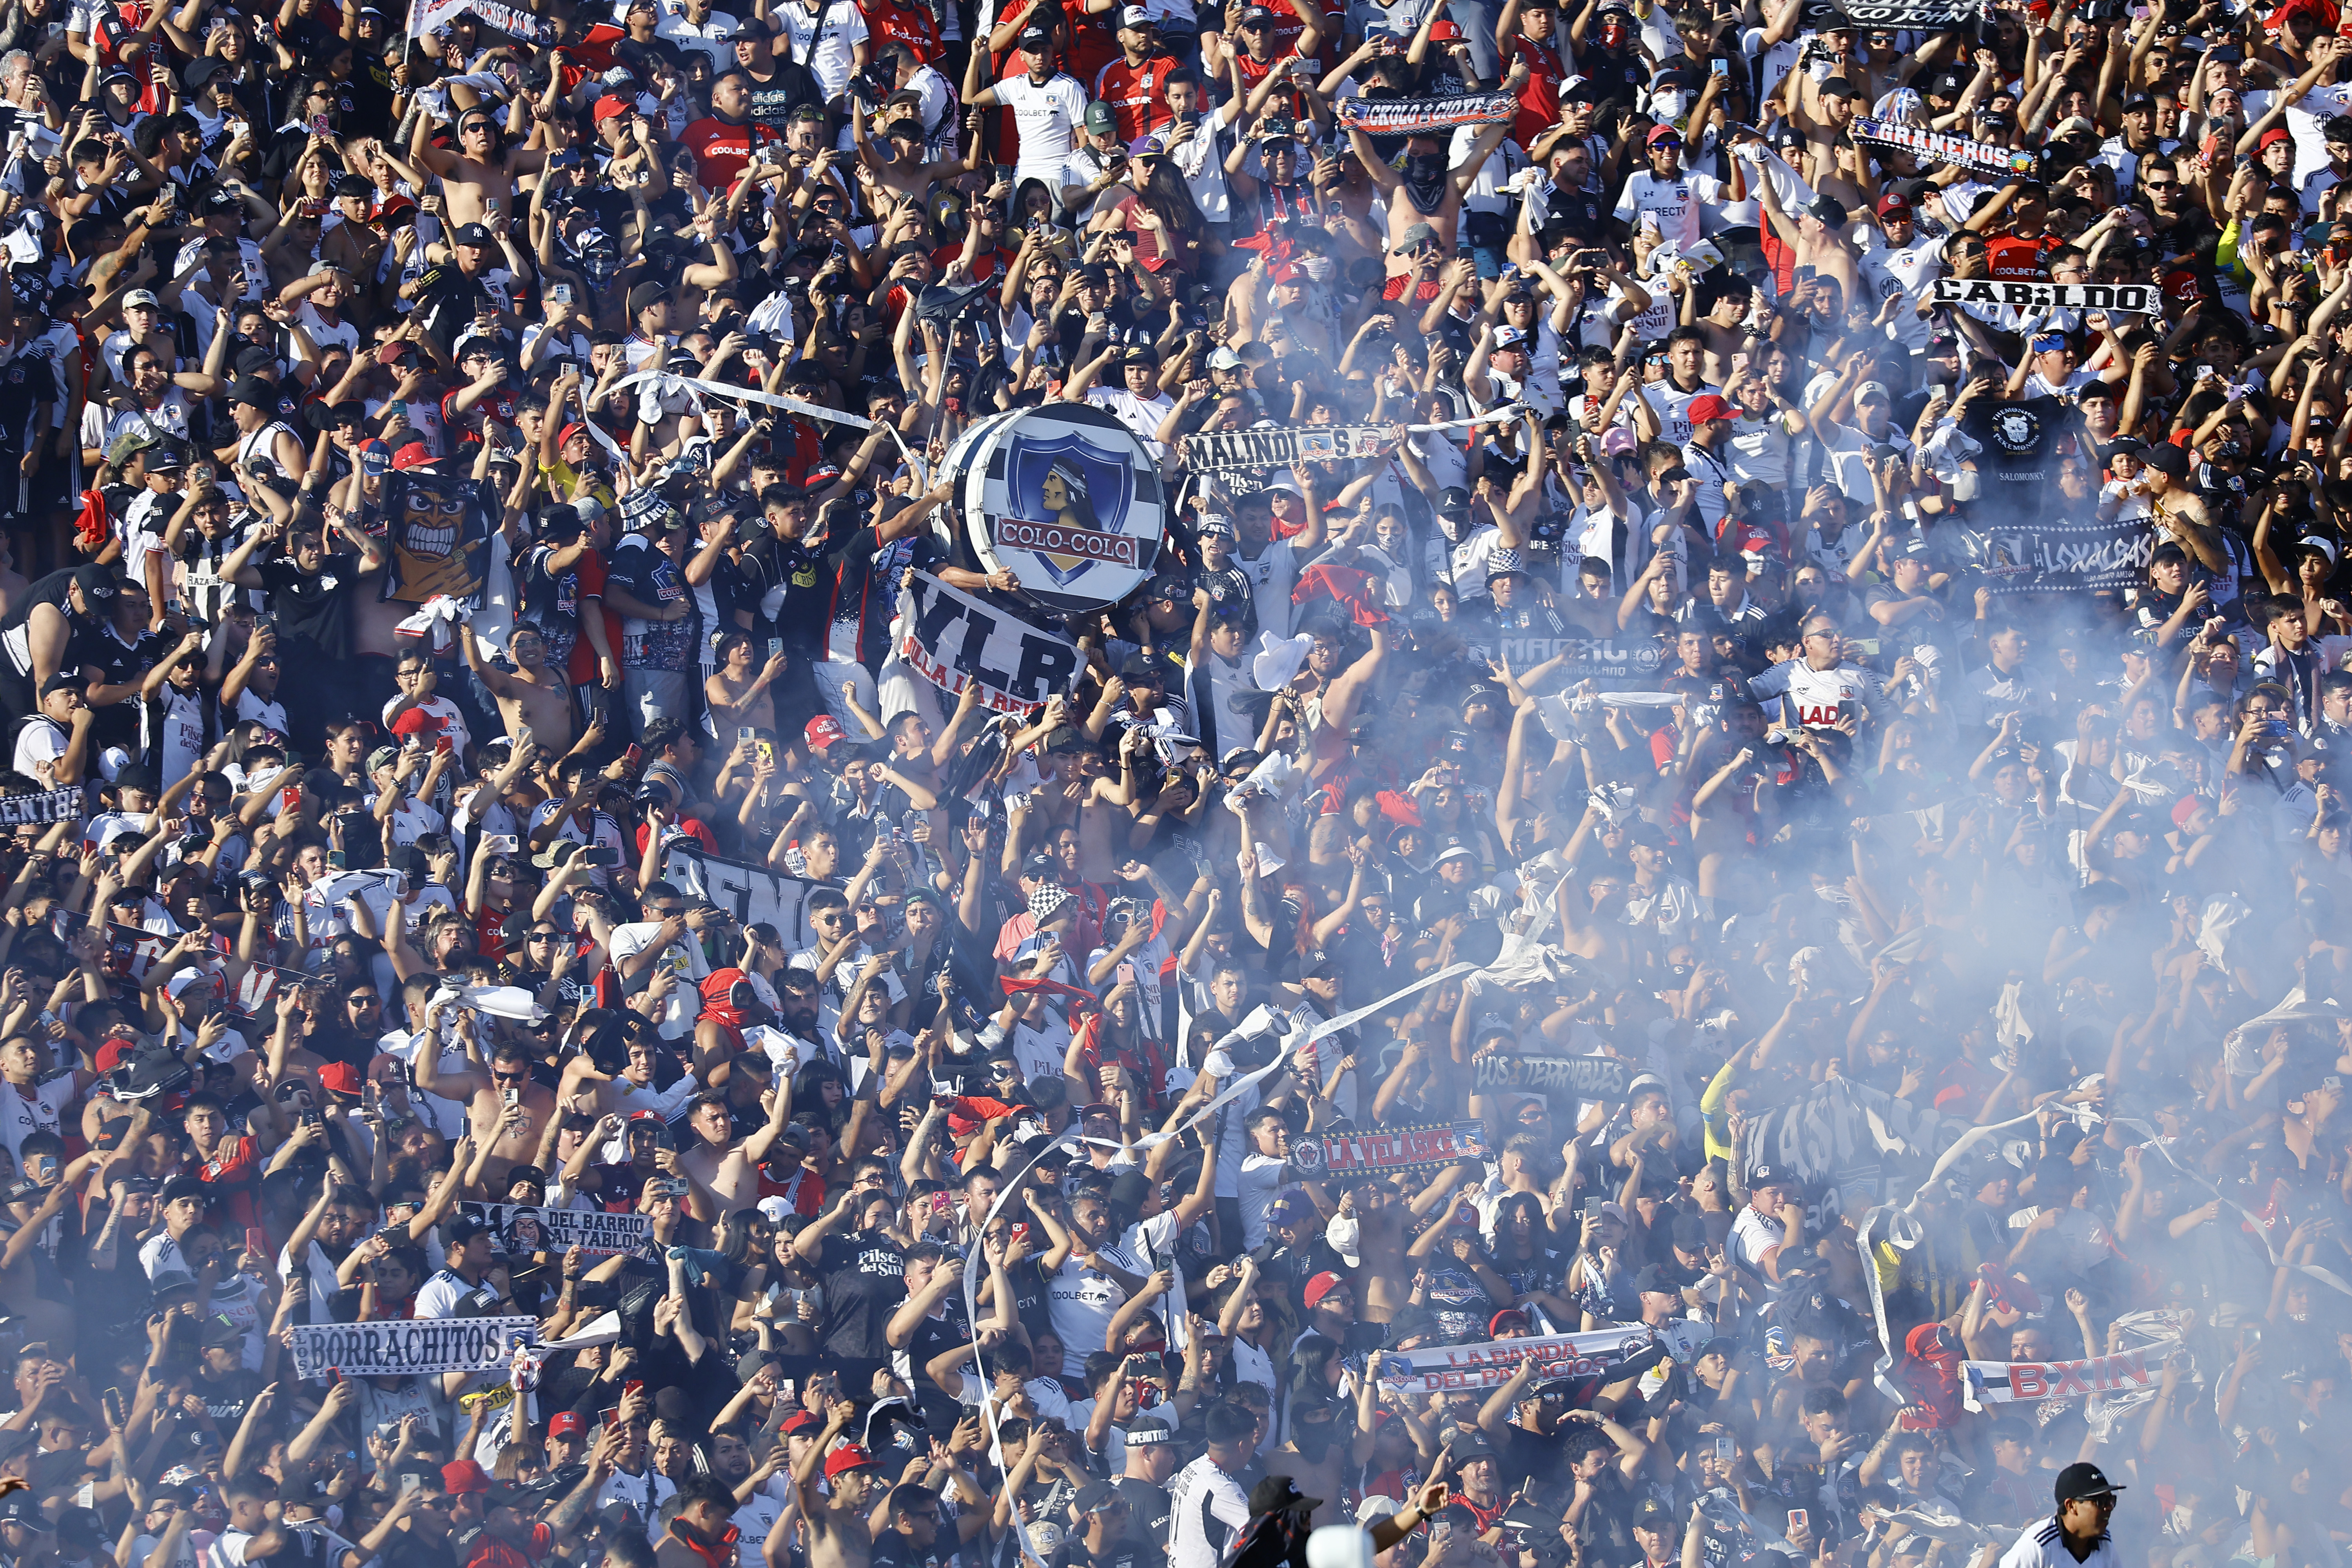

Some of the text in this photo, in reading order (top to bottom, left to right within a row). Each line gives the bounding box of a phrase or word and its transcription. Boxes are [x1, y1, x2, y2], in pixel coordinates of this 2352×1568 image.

[1946, 76, 1956, 87] NY
[1112, 96, 1140, 108] OOLBET
[1369, 104, 1421, 125] CKOLO
[1782, 135, 1792, 145] NY
[1879, 123, 2009, 168] GRANEROS
[1645, 206, 1685, 216] RECTV
[473, 227, 482, 237] NY
[1289, 265, 1299, 274] LA
[1995, 268, 2036, 276] COOLBET
[1646, 316, 1668, 330] Sur
[1991, 407, 2038, 422] THEMONIOS
[1219, 471, 1263, 490] Pilsen
[1002, 522, 1131, 559] COLO-COLO
[1529, 540, 1549, 550] IRE
[189, 575, 209, 585] RAZA
[1314, 951, 1326, 961] NY
[1324, 1129, 1457, 1169] LA VELASKE
[550, 1212, 644, 1233] DEL BARRIO
[860, 1262, 878, 1273] del
[1053, 1291, 1094, 1301] COOLBET
[313, 1325, 500, 1369] BORRACHITOS
[1447, 1341, 1580, 1369] LA BANDA
[1424, 1357, 1609, 1390] DEL PACIOS
[2007, 1347, 2151, 1400] BXIN
[463, 1388, 514, 1410] CSTAL
